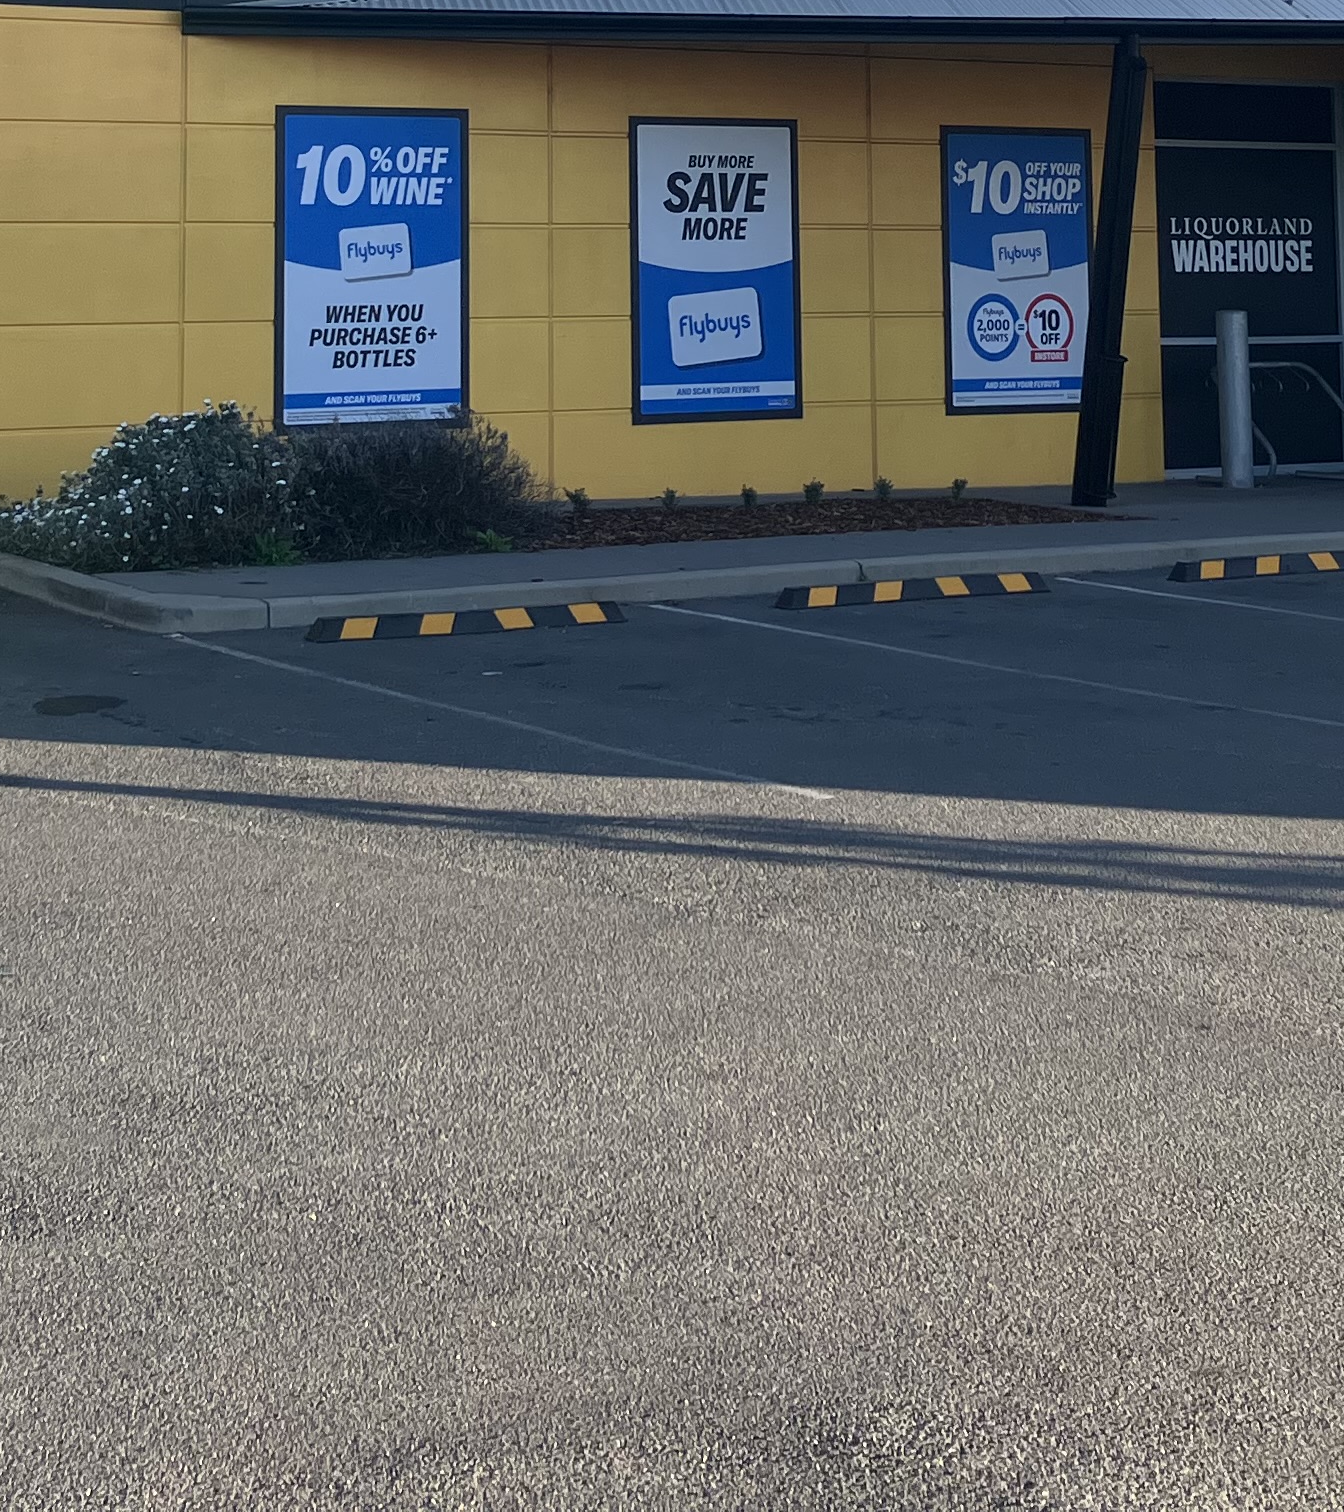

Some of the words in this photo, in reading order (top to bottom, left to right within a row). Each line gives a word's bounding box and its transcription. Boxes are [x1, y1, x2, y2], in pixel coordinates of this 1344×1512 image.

[396, 146, 449, 174] OFF
[688, 155, 715, 168] BUY
[717, 155, 754, 168] MORE
[663, 172, 768, 213] SAVE
[953, 158, 1022, 214] $10
[1026, 162, 1048, 176] OFF
[1050, 162, 1081, 176] YOUR
[1023, 177, 1081, 200] SHOP
[682, 217, 748, 240] MORE
[1170, 217, 1313, 239] LIQUORLAND
[1171, 240, 1313, 272] WAREHOUSE
[326, 305, 382, 323] WHEN
[387, 304, 424, 322] YOU
[1033, 309, 1060, 331] $10
[977, 319, 1010, 332] 2,000
[309, 327, 412, 346] PURCHASE
[415, 326, 438, 344] 6+
[980, 334, 1008, 342] POINTS
[1041, 333, 1060, 344] OFF
[332, 349, 416, 369] BOTTLES
[325, 396, 342, 405] AND
[344, 396, 365, 404] SCAN
[367, 395, 387, 403] YOUR
[388, 393, 422, 402] FLYBUYS
[677, 388, 691, 396] AND
[692, 387, 712, 395] SCAN
